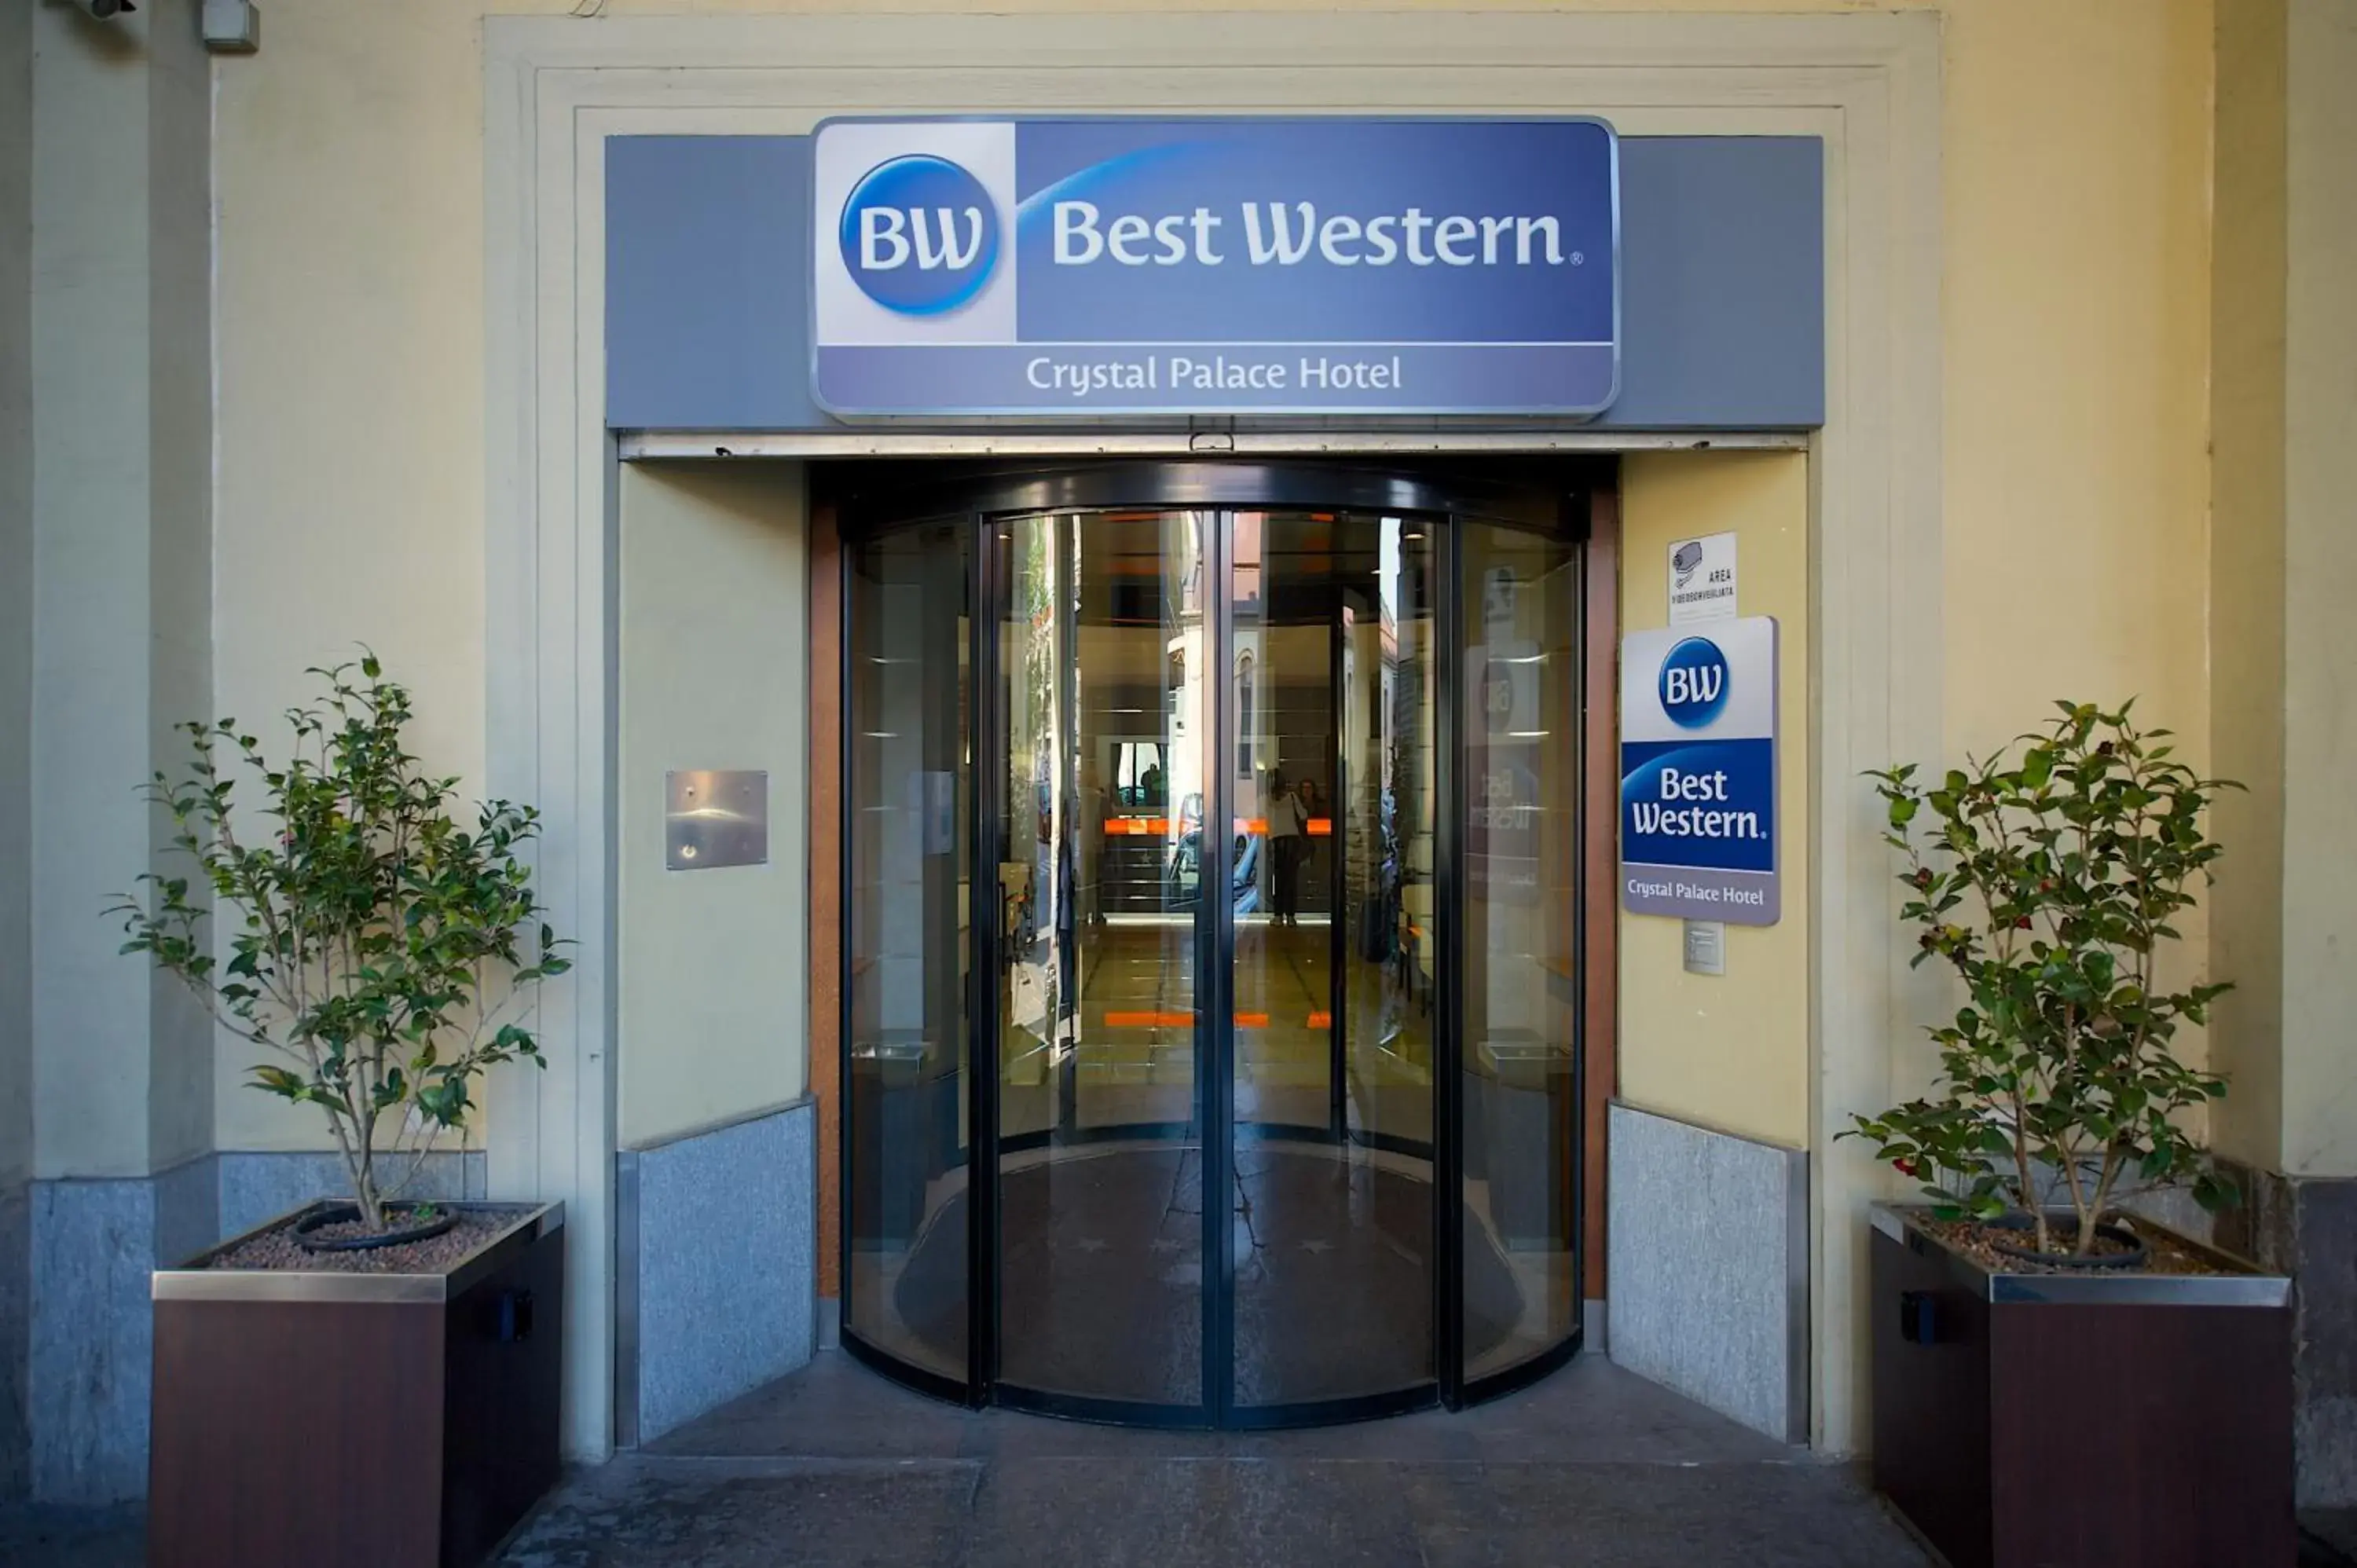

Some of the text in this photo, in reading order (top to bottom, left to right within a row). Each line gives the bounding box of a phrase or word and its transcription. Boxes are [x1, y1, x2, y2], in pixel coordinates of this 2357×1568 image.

[860, 206, 984, 272] BW
[1054, 201, 1223, 265] Best
[1026, 356, 1402, 397] Crystal Palace Hotel
[1709, 569, 1732, 584] AREA
[1666, 664, 1722, 705] BW
[1661, 768, 1728, 801] Best
[1627, 879, 1765, 905] Crystal Palace Hotel
